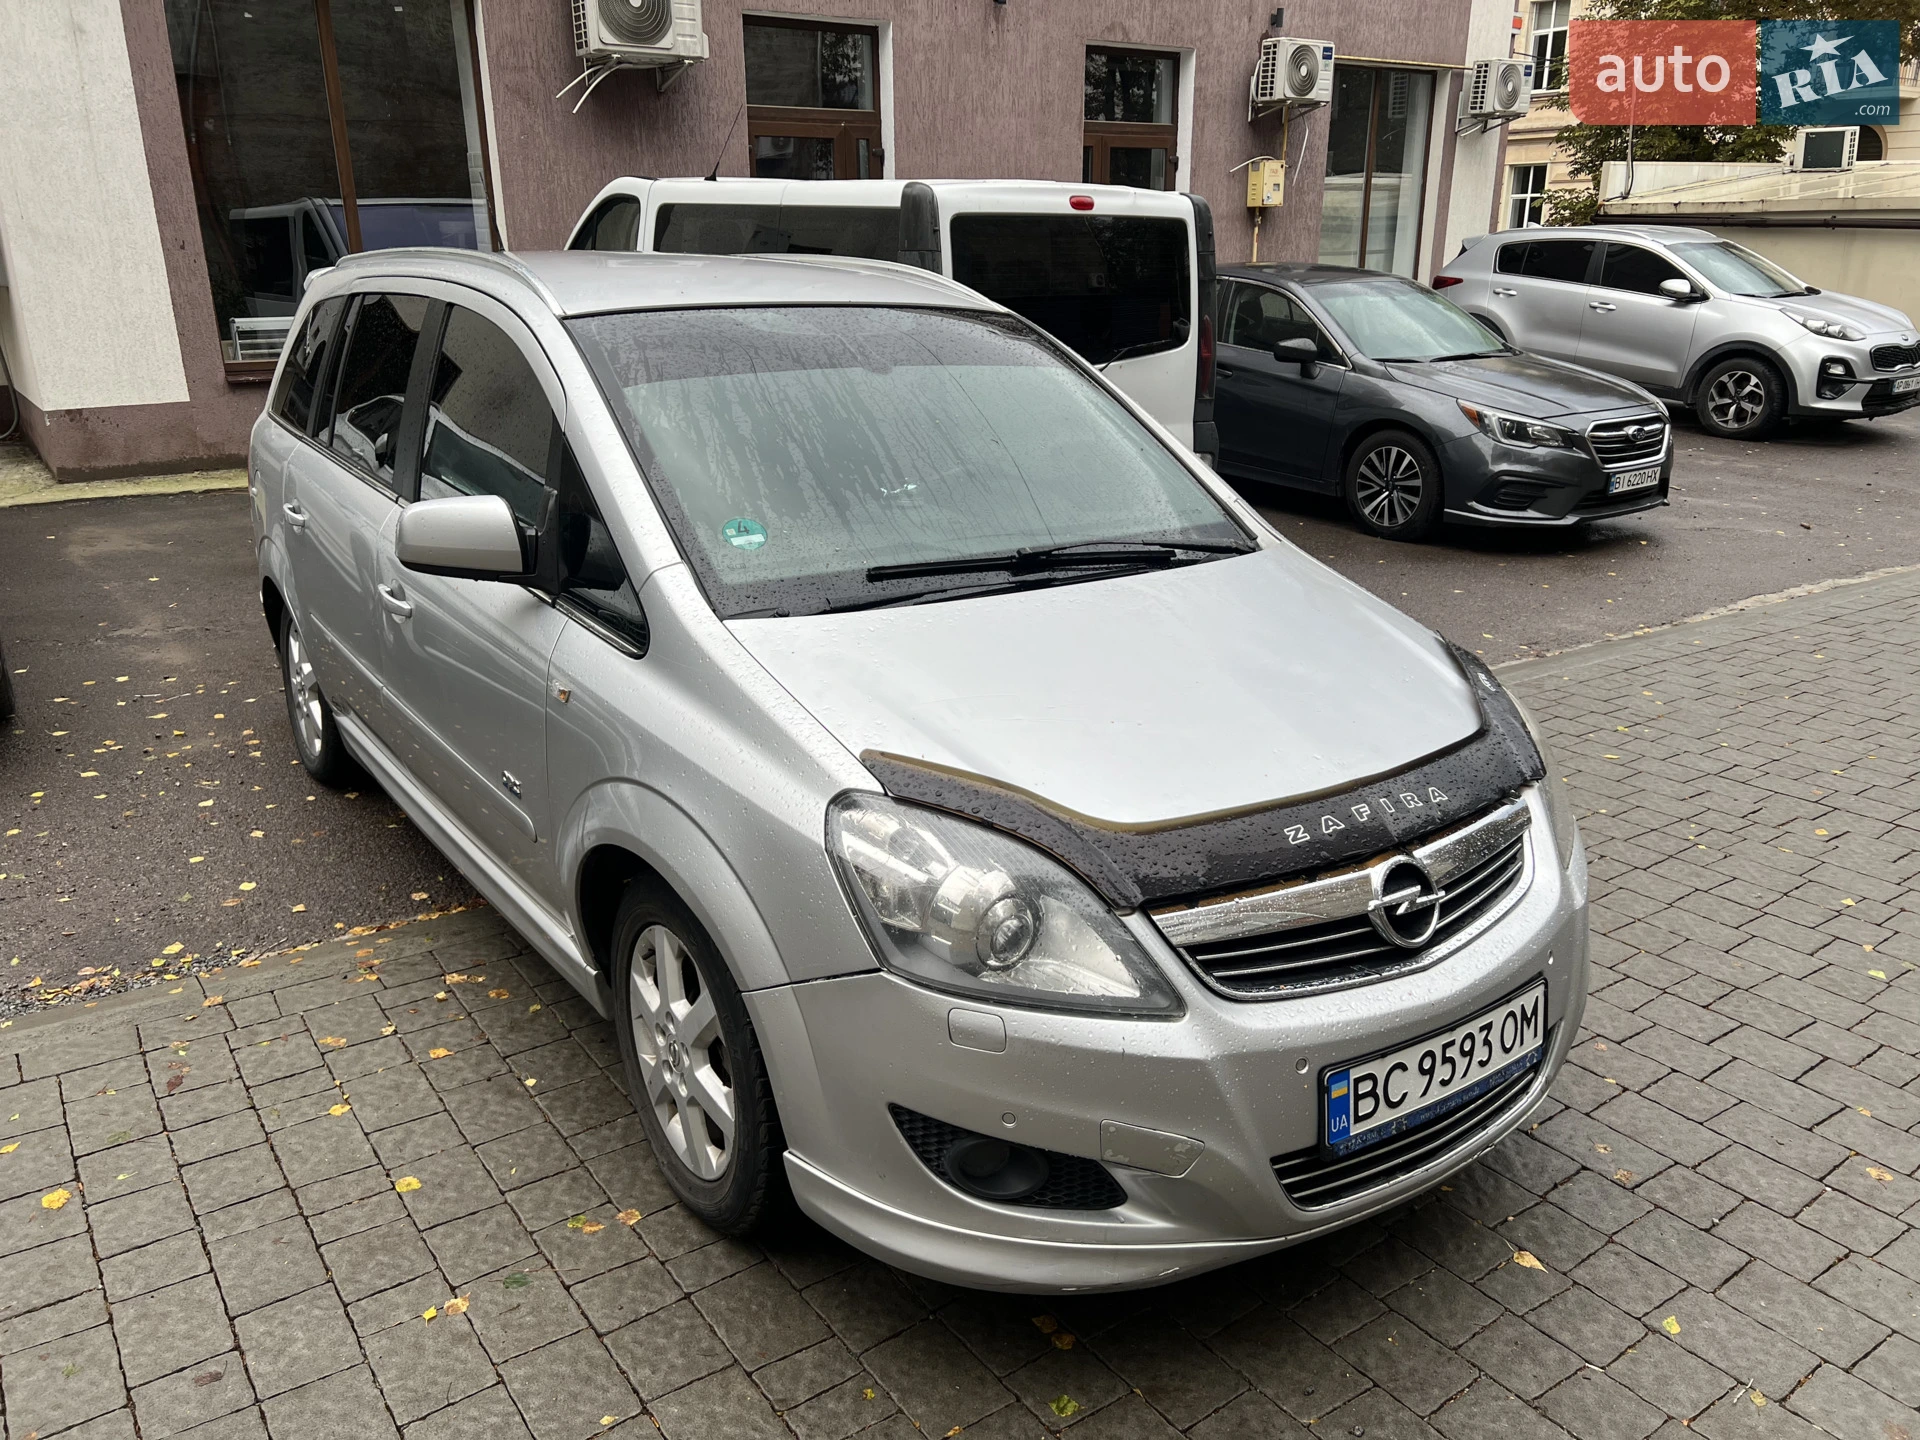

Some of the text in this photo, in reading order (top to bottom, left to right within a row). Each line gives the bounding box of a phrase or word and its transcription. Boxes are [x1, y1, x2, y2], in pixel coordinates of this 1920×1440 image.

[1615, 476, 1626, 490] BI
[1627, 472, 1646, 487] 6220
[1646, 469, 1659, 483] HX
[737, 520, 750, 534] 4
[1284, 786, 1449, 845] ZAFIRA
[1353, 1061, 1409, 1125] BC
[1417, 1020, 1494, 1098] 9593
[1500, 995, 1539, 1054] OM
[1331, 1114, 1348, 1132] UA
